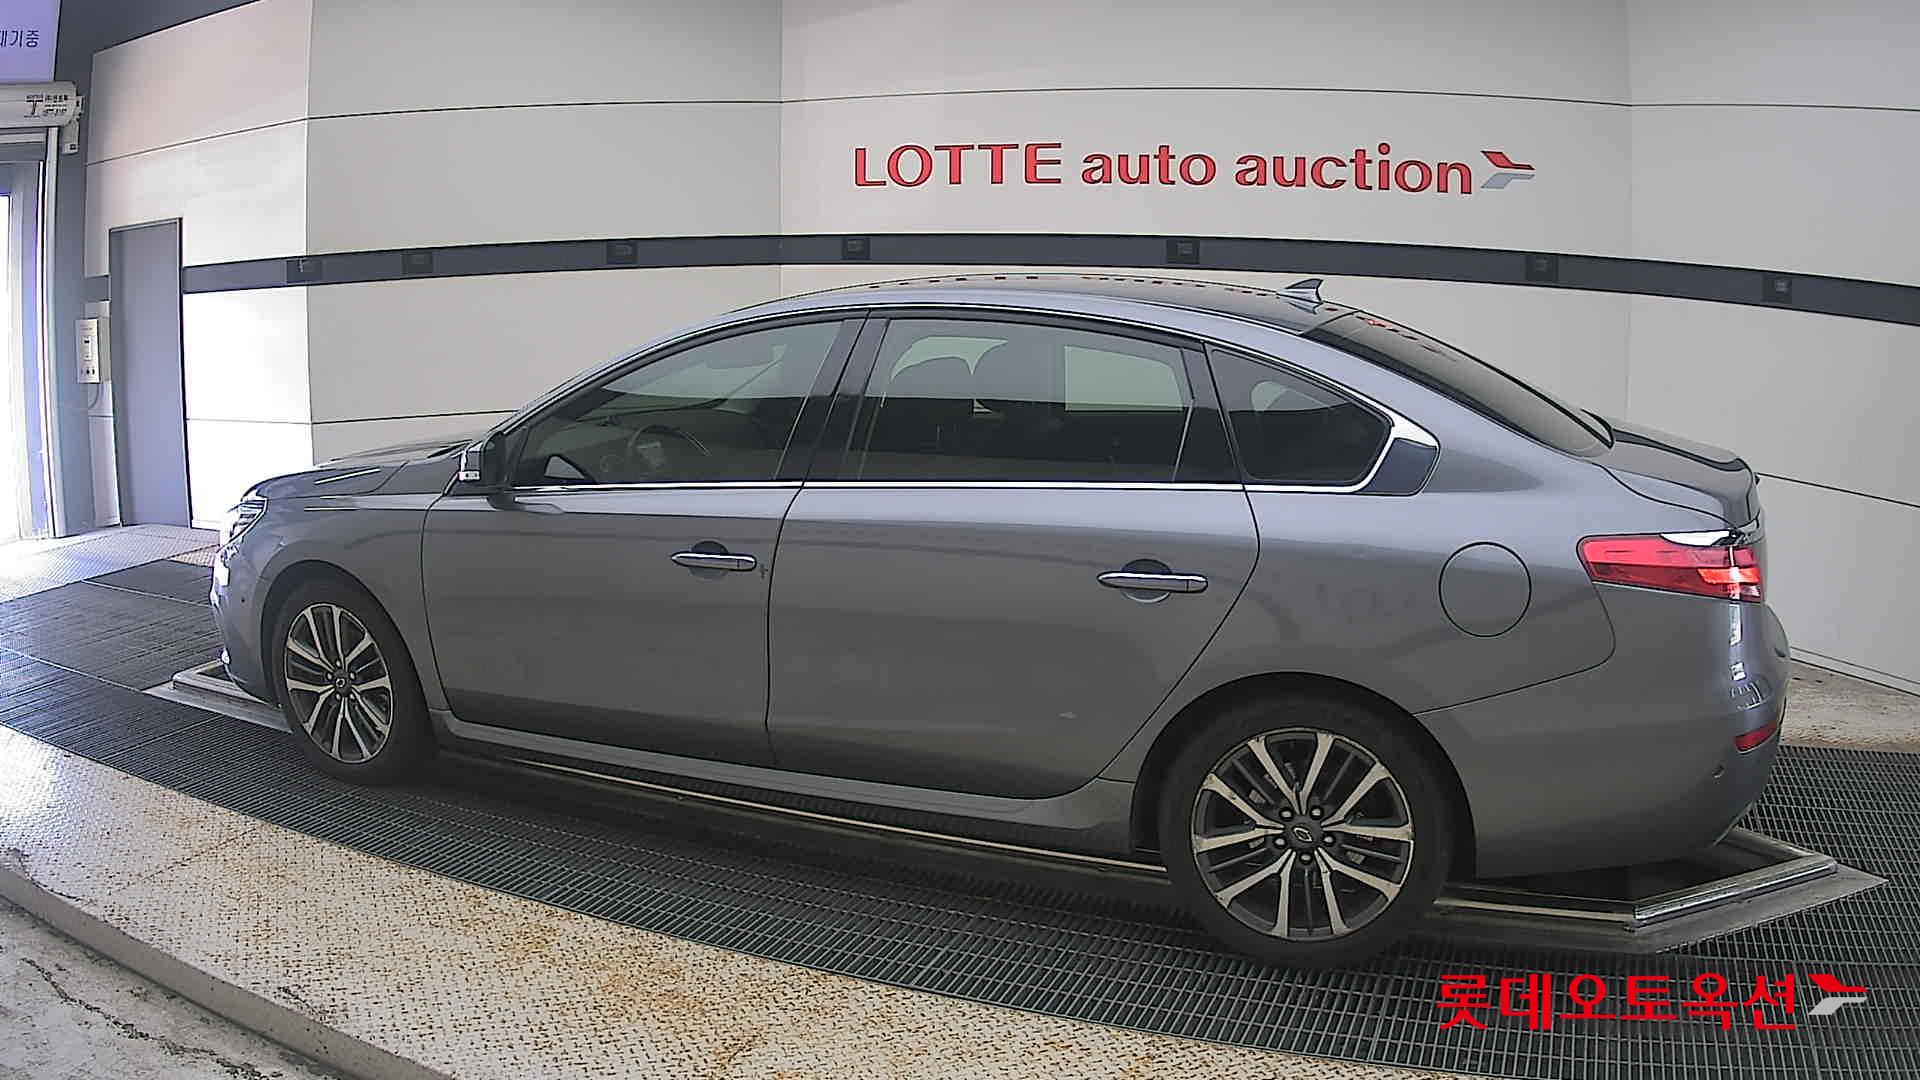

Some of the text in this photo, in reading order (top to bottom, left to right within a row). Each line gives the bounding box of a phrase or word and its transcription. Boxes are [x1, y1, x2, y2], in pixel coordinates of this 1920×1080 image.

[854, 142, 1473, 194] LOTTE auto auction
